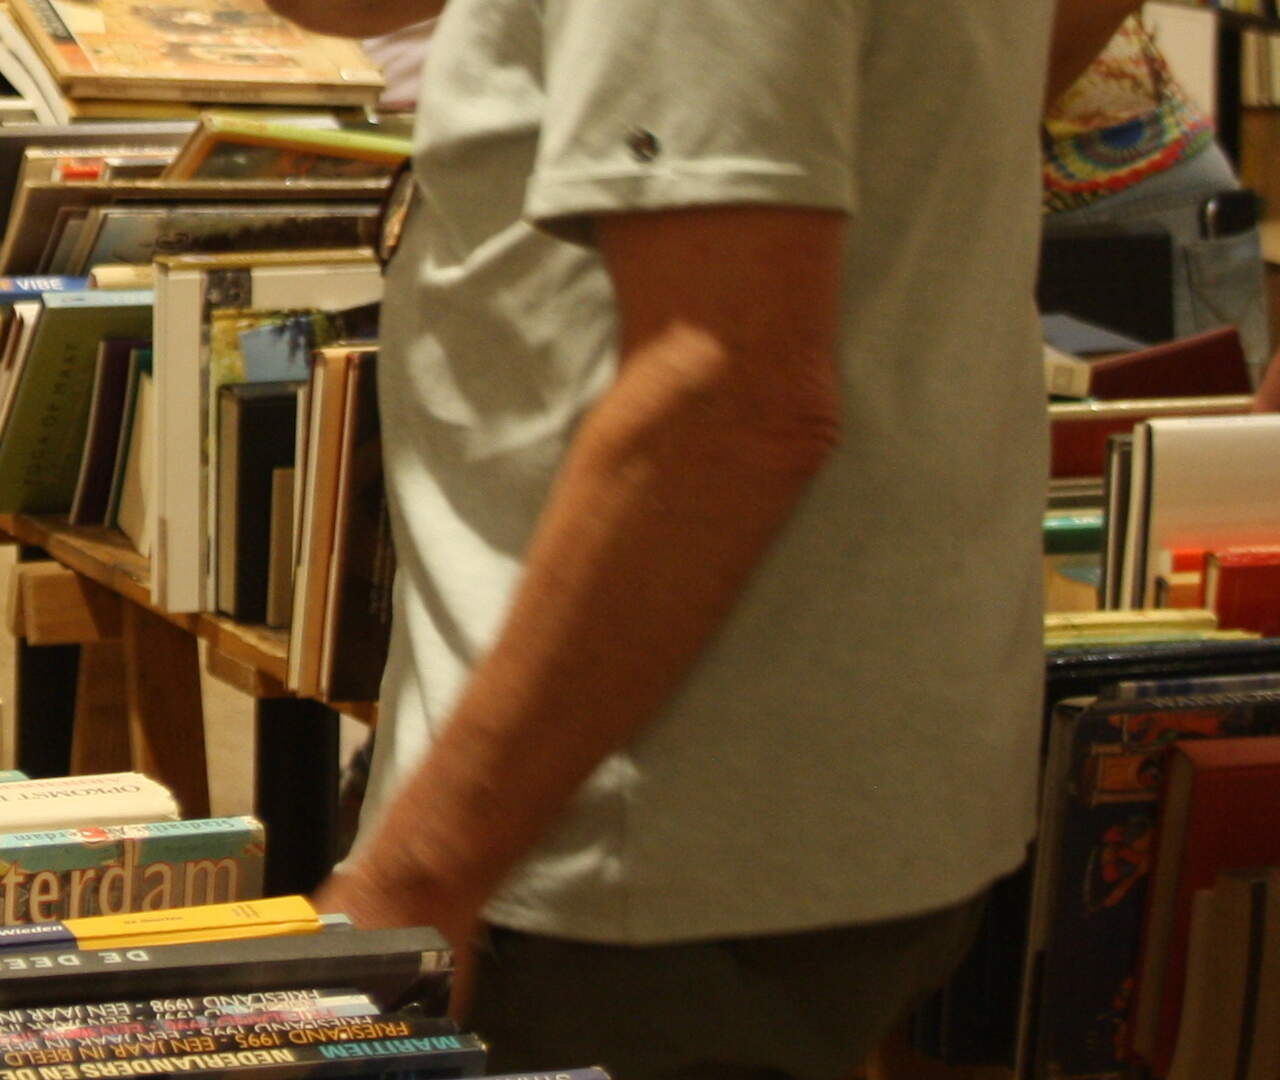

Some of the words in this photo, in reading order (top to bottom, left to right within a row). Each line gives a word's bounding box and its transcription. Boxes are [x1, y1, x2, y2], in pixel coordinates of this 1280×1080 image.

[17, 785, 141, 801] OPKOMST
[98, 949, 150, 965] DE
[149, 997, 195, 1013] 1998
[203, 988, 320, 1010] FRIESLAND
[26, 1005, 82, 1022] JAAR
[86, 1002, 131, 1018] EEN
[234, 1032, 280, 1049] 1995
[288, 1020, 410, 1044] FRIESLAND
[110, 1040, 165, 1059] JAAR
[172, 1036, 216, 1054] EEN
[317, 1034, 463, 1060] MARITIEM
[3, 1048, 73, 1068] BEELD
[78, 1046, 105, 1062] IN
[79, 1047, 298, 1079] NEDERLANDERS
[38, 1064, 78, 1080] EN
